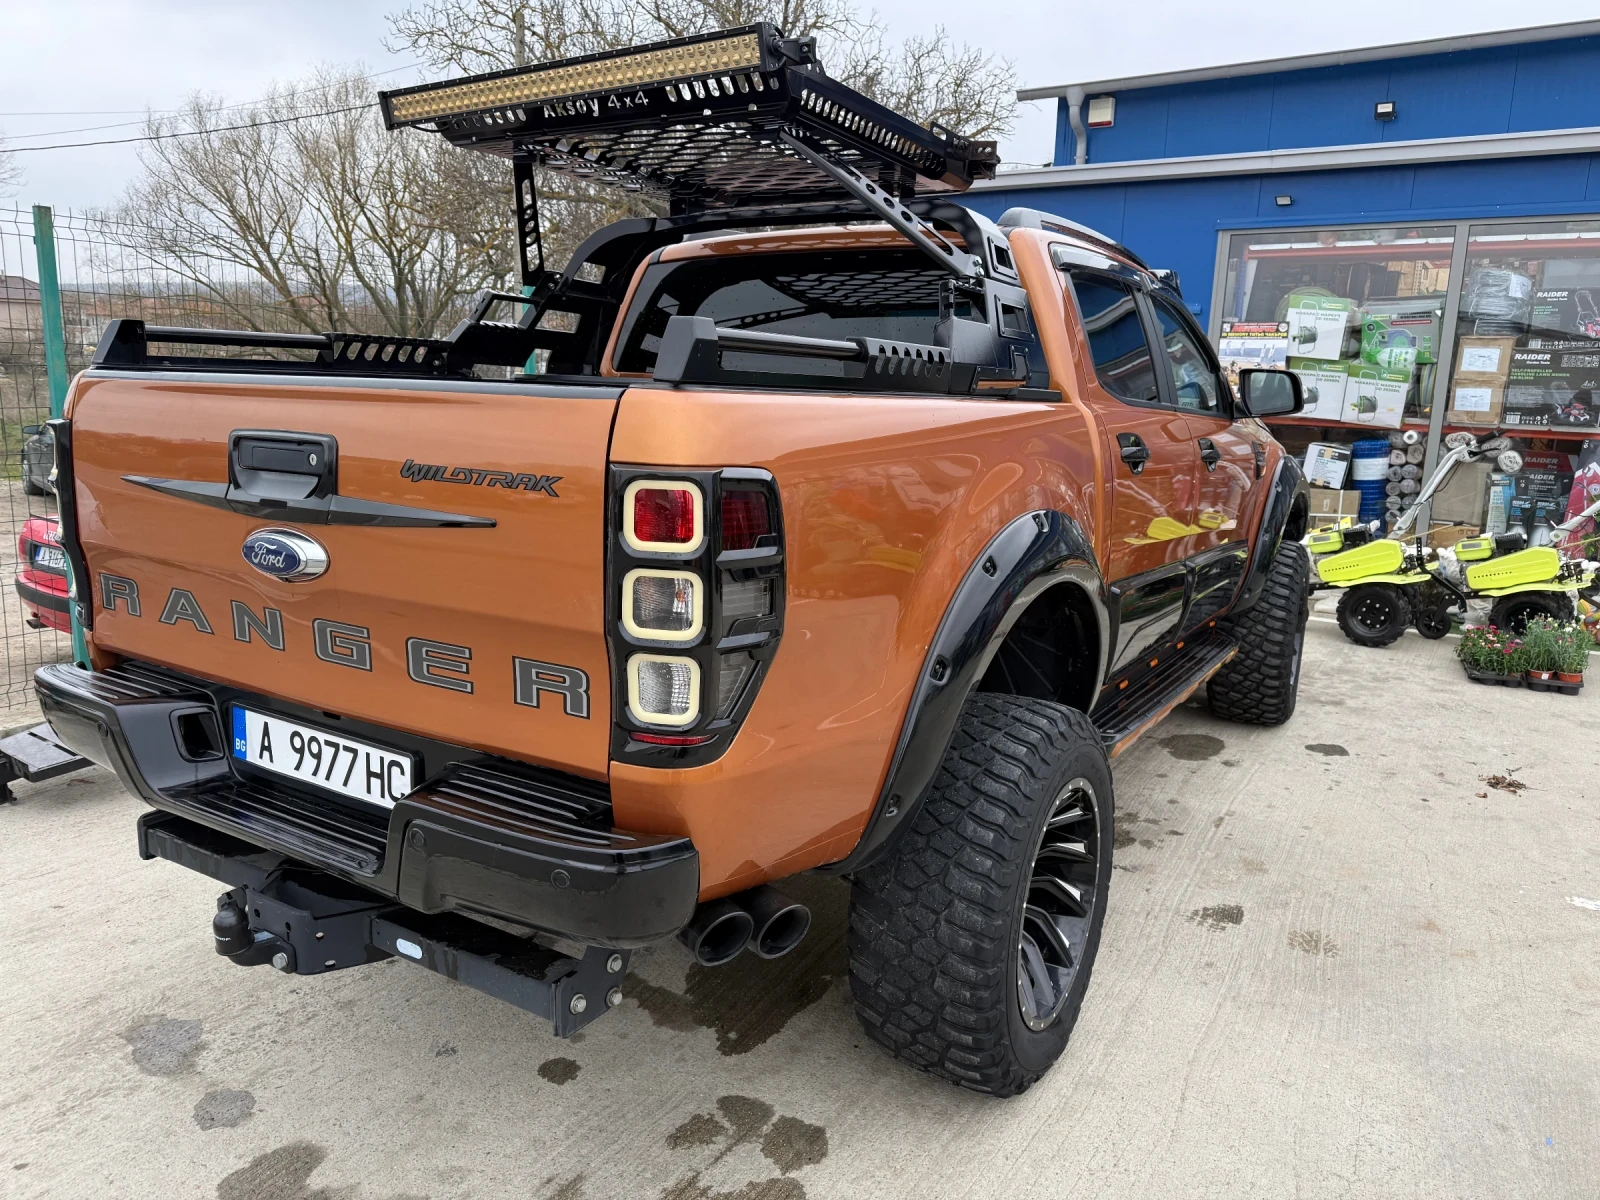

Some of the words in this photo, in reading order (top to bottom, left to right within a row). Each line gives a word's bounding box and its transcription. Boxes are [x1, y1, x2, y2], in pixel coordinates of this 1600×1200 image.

[607, 91, 649, 109] 4x4
[1524, 456, 1559, 464] RAIDER
[400, 459, 563, 497] WILDTRAK
[1529, 473, 1555, 481] AIDER
[251, 541, 287, 569] Ford
[100, 573, 591, 719] RANGER
[235, 738, 246, 752] BG
[259, 721, 274, 764] A
[289, 730, 359, 788] 9977
[365, 751, 406, 802] HC
